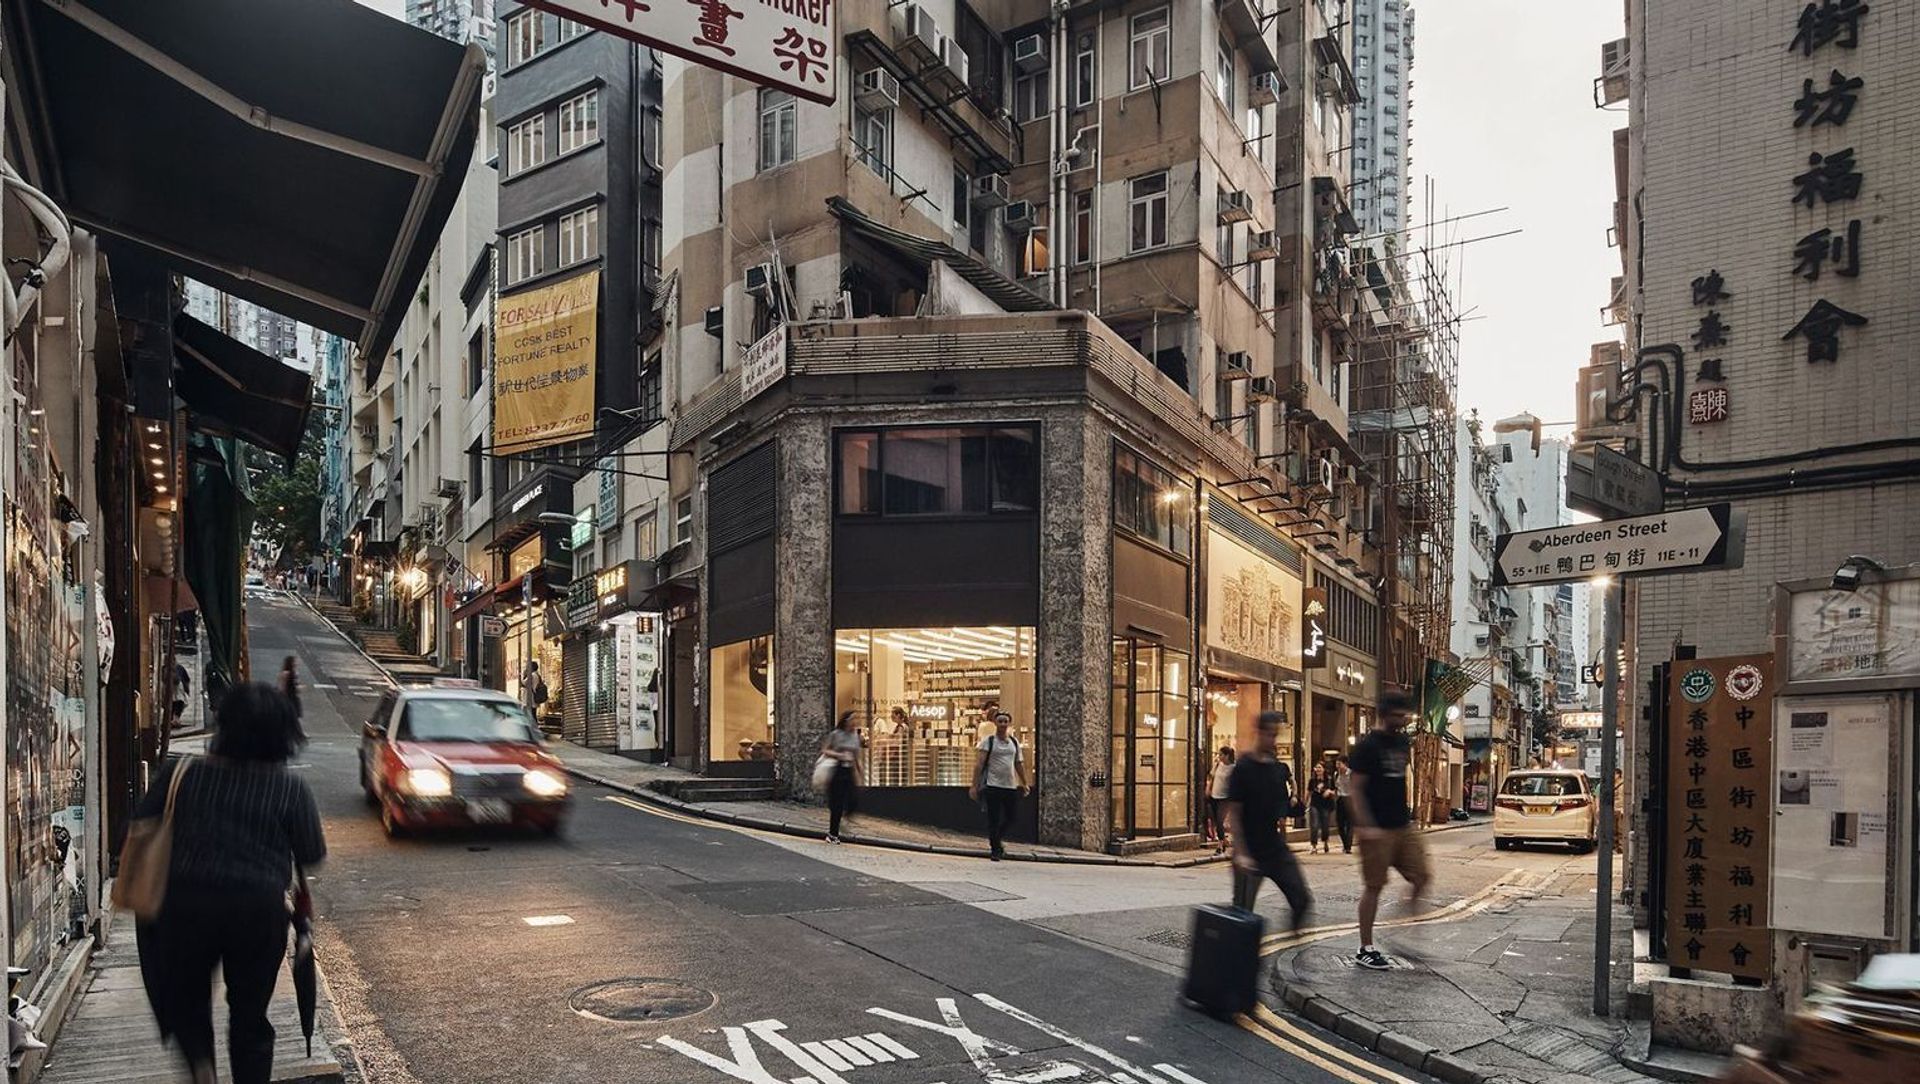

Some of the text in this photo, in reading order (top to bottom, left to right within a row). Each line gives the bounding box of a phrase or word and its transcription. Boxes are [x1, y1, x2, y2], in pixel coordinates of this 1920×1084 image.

[1784, 0, 1870, 363] 街坊福利會
[500, 306, 525, 326] FOR
[546, 325, 574, 342] BEST
[498, 336, 592, 367] FORTUNE REALTY
[1542, 519, 1668, 551] Aberdeen Street
[1557, 548, 1647, 573] 鴨巴甸街
[1728, 706, 1757, 966] 中區街坊福利會
